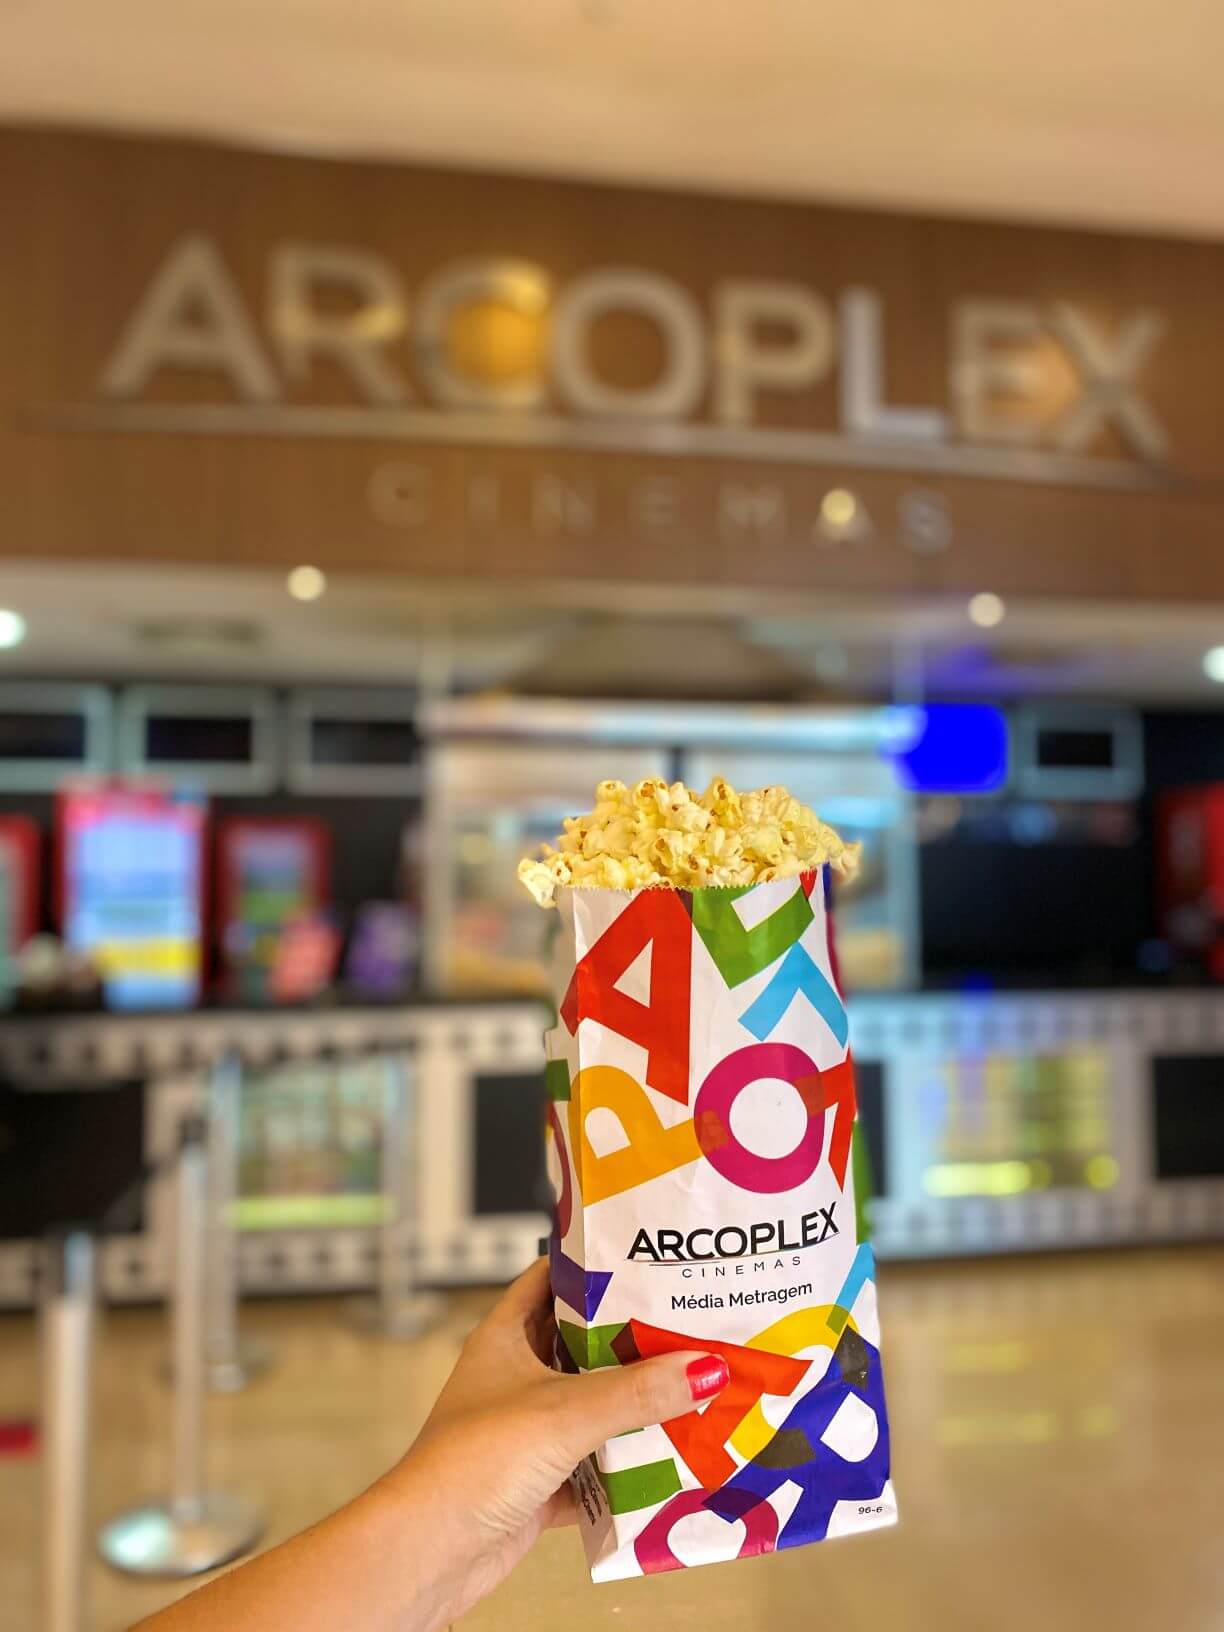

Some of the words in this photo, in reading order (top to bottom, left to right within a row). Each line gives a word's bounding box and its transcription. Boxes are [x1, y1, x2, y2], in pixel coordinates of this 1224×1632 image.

[101, 233, 1170, 461] ARCOPLEX
[626, 1201, 840, 1262] ARCOPLEX
[681, 1256, 801, 1279] CINEMAS
[671, 1293, 724, 1310] Média
[729, 1283, 813, 1307] Metragem
